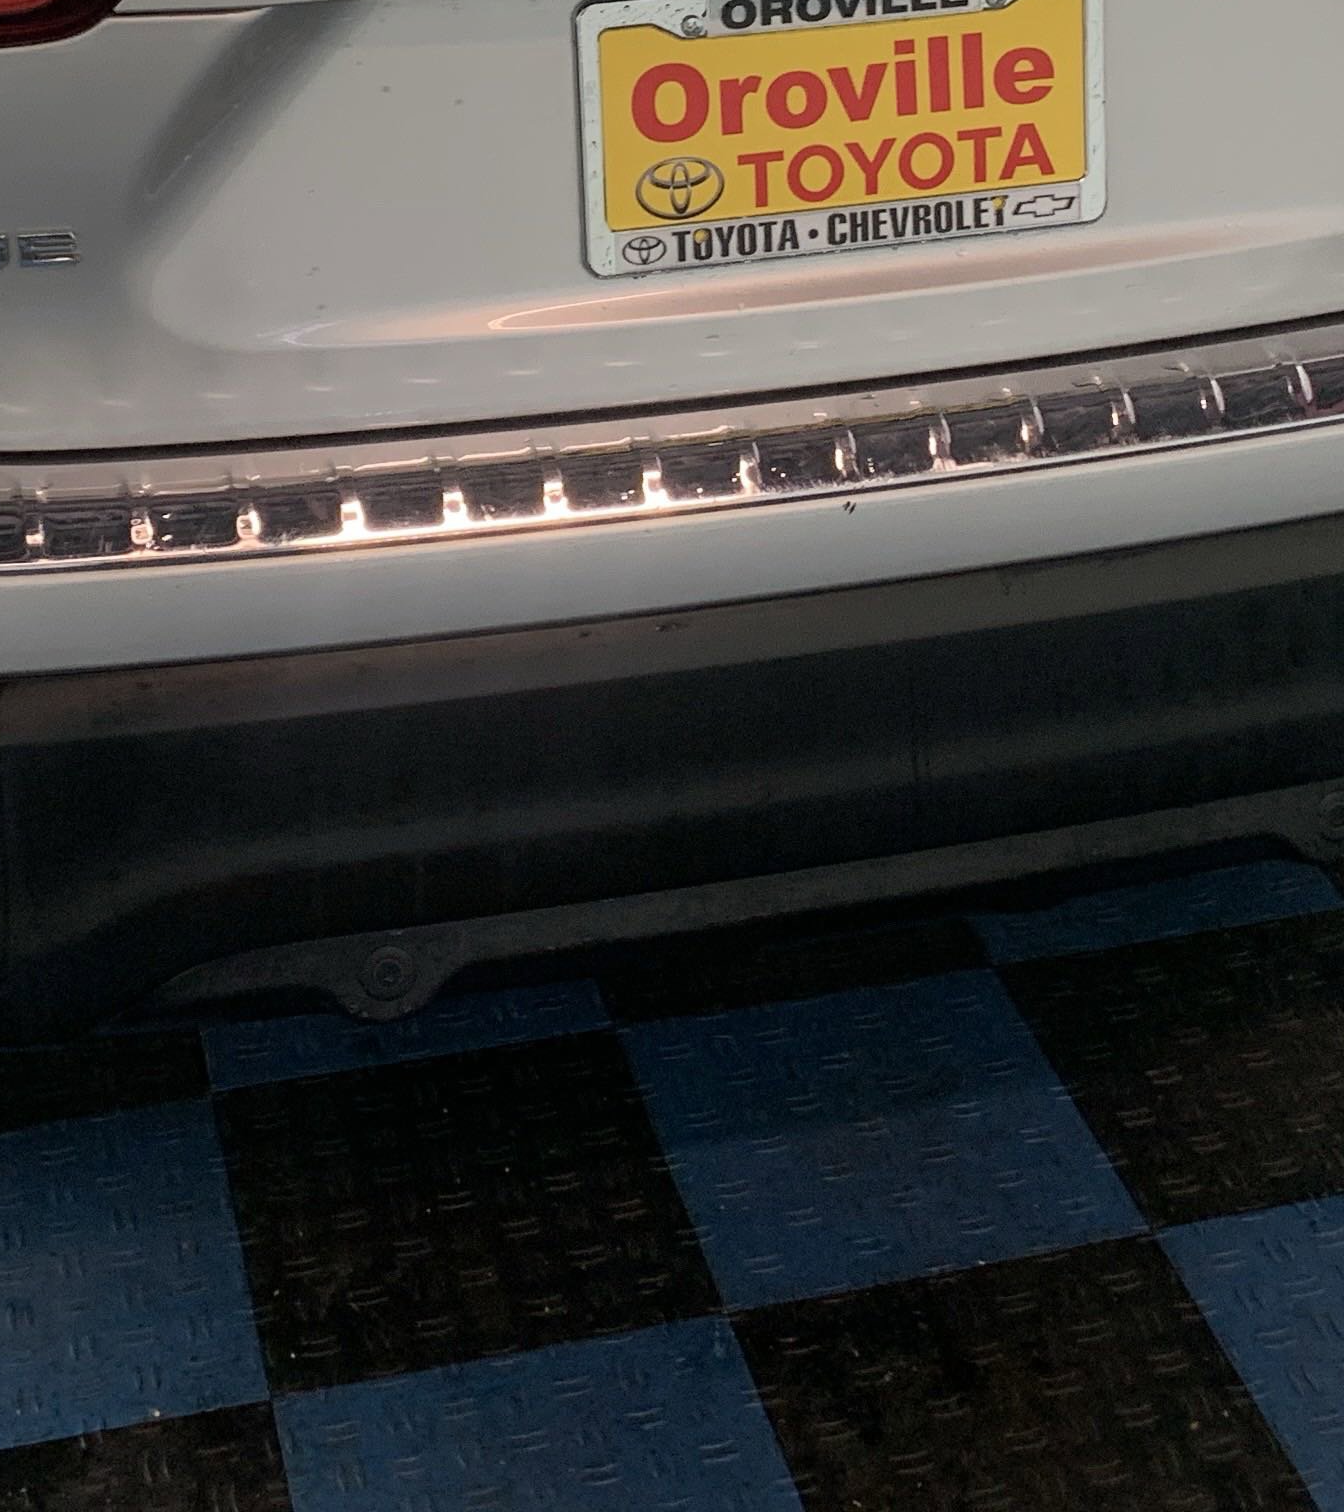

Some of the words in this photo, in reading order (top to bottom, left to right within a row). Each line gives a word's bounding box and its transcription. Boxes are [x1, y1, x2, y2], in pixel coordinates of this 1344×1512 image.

[631, 32, 1055, 143] Oroville
[737, 123, 1055, 208] TOYOTA
[672, 219, 799, 262] TOYOTA
[827, 195, 1008, 246] CHEVROLET
